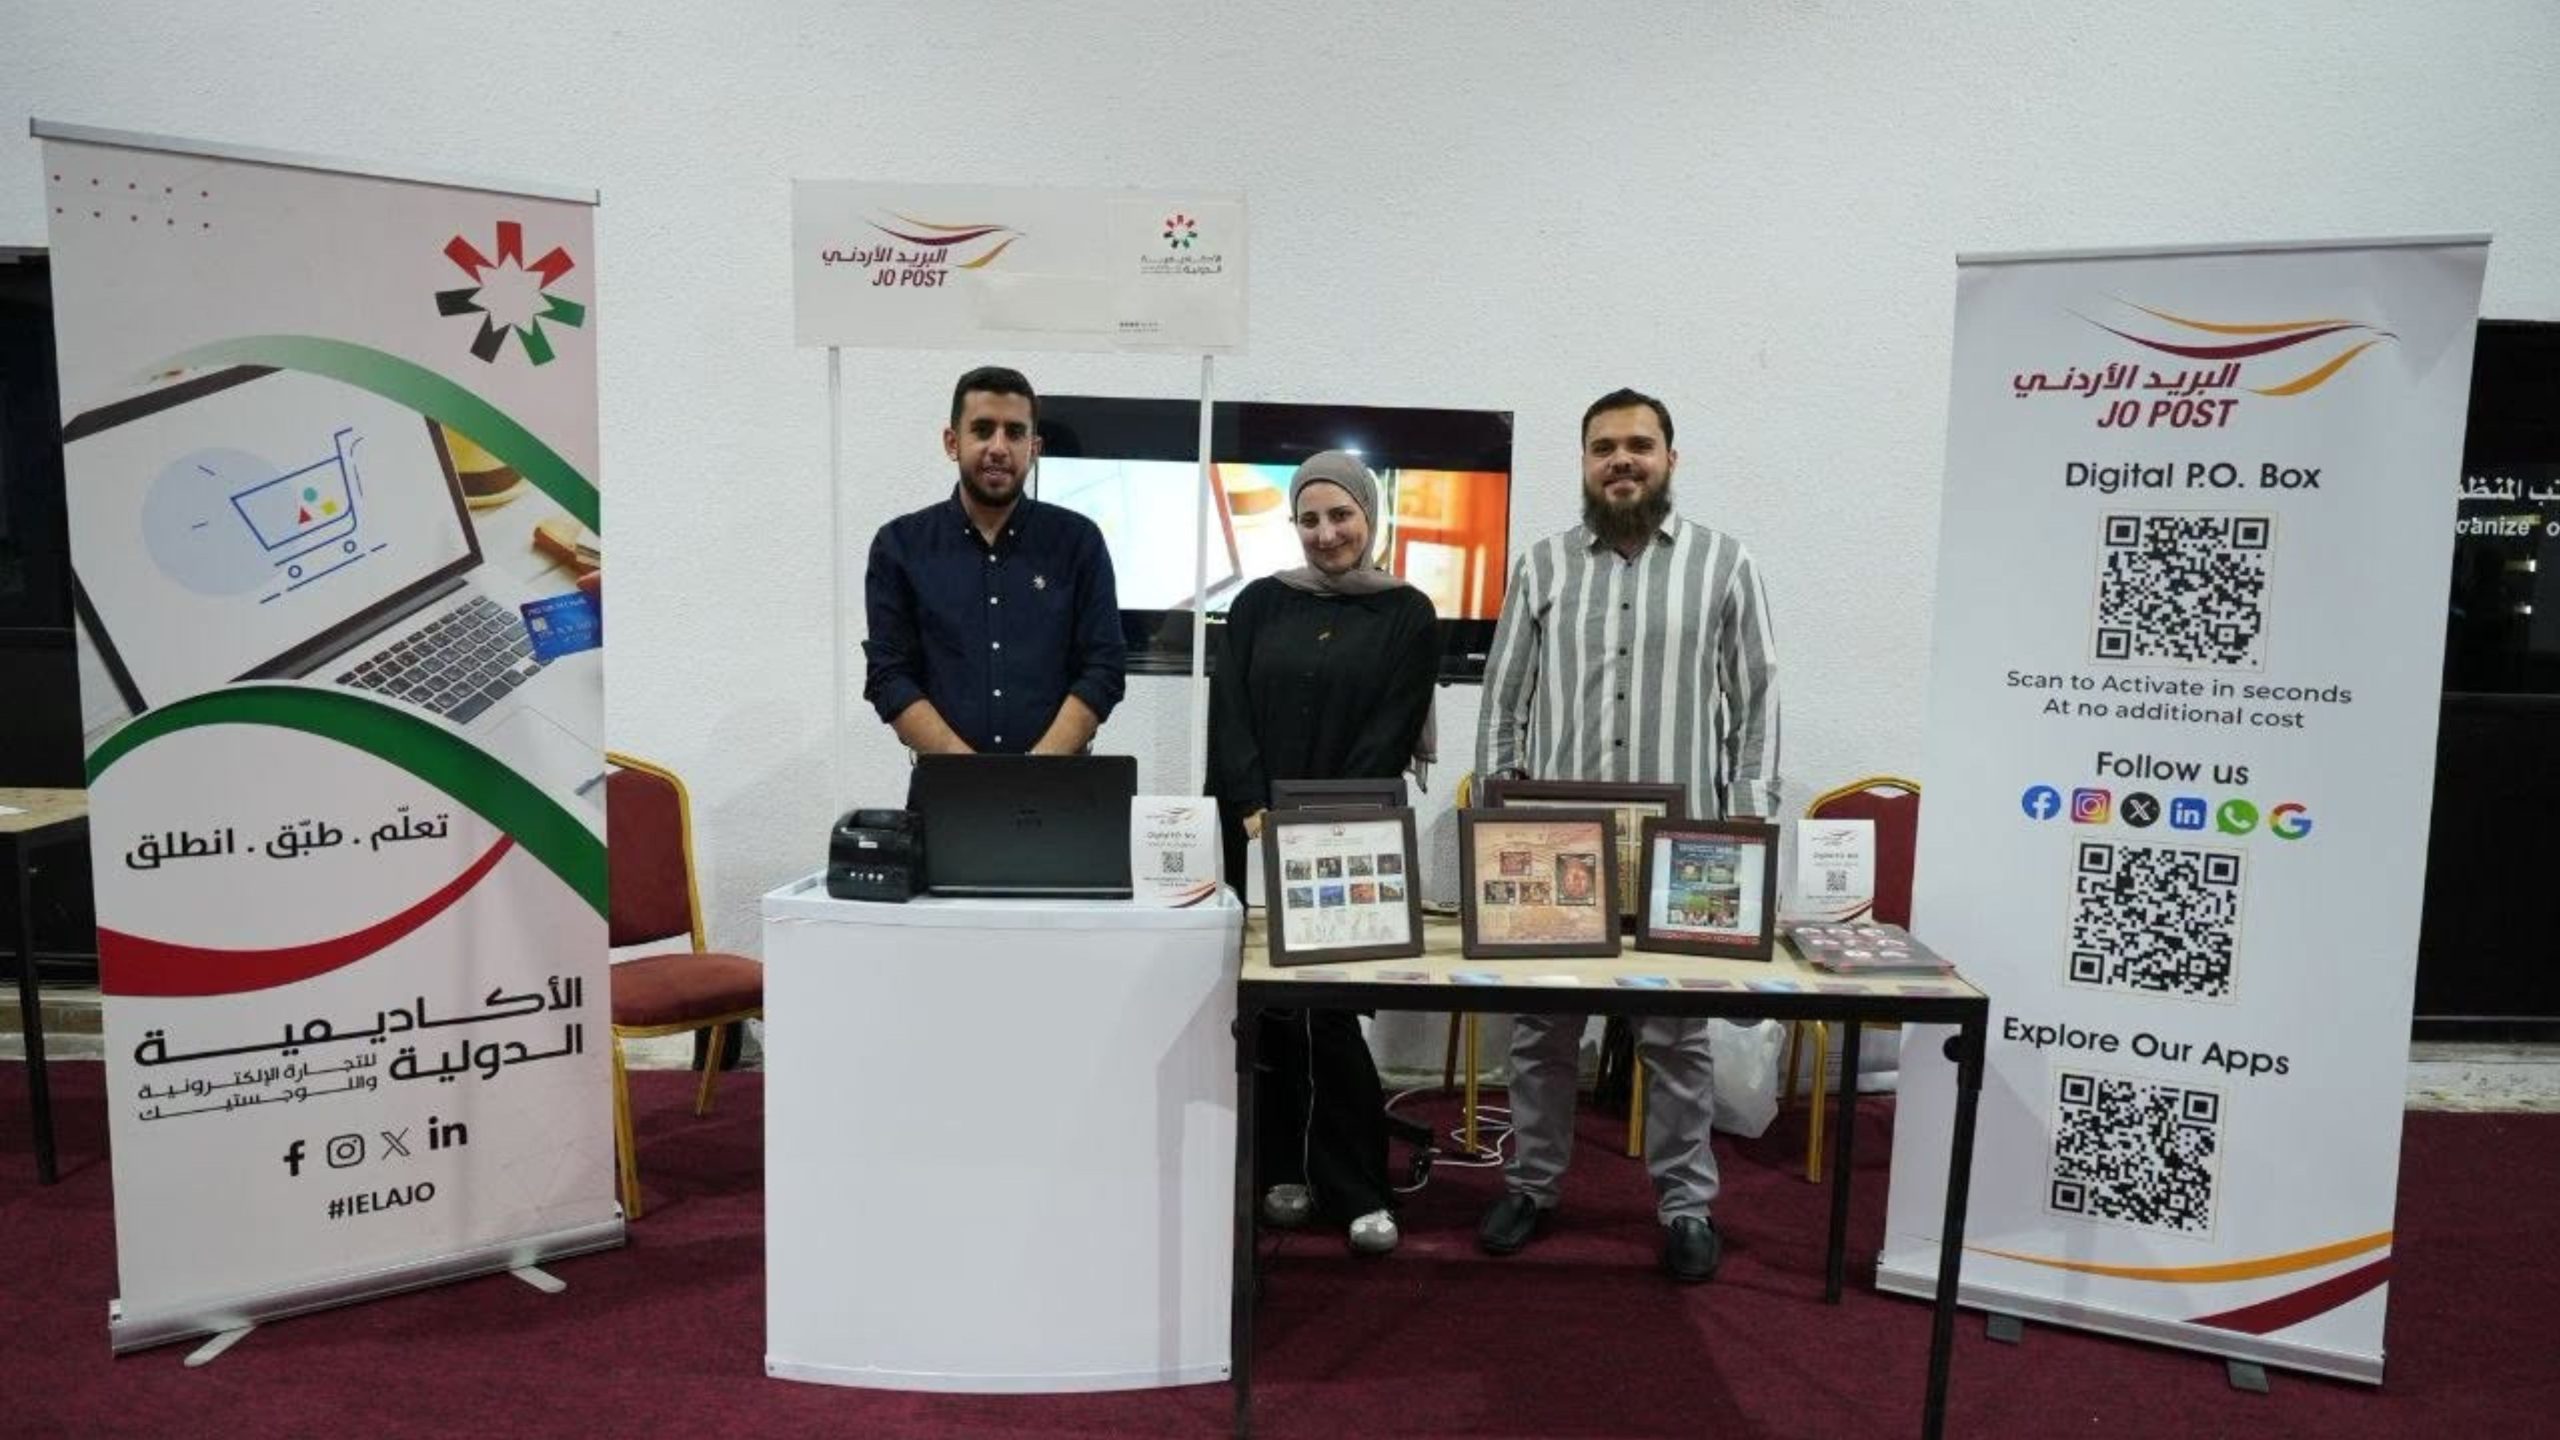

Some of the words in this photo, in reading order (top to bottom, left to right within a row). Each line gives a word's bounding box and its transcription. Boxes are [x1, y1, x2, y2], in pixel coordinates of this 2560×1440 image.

[822, 244, 893, 268] الأردني
[895, 247, 948, 268] البريد
[872, 269, 896, 287] JO
[900, 269, 948, 287] POST
[2013, 362, 2139, 398] الأردني
[2143, 362, 2241, 395] البريد
[2097, 400, 2141, 428] JO
[2148, 399, 2239, 428] POST
[2065, 462, 2173, 494] Digital
[2186, 462, 2244, 489] P.O.
[2259, 463, 2321, 489] Box
[2006, 671, 2063, 690] Scan
[2071, 674, 2095, 691] to
[2101, 674, 2205, 697] Activate
[2212, 679, 2235, 699] in
[2242, 684, 2353, 704] seconds
[2043, 699, 2070, 715] At
[2078, 702, 2109, 717] no
[2115, 702, 2242, 725] additional
[2249, 709, 2305, 729] cost
[2096, 752, 2202, 782] Follow
[2213, 763, 2250, 785] us
[126, 828, 235, 870] انطلق
[134, 976, 582, 1066] الأكاديمية
[389, 1023, 583, 1082] الدولية
[2003, 1016, 2119, 1053] Explore
[2131, 1033, 2193, 1062] Our
[2202, 1042, 2290, 1077] Apps
[283, 1053, 377, 1082] للتجارة
[328, 1182, 435, 1219] #IELAJO
